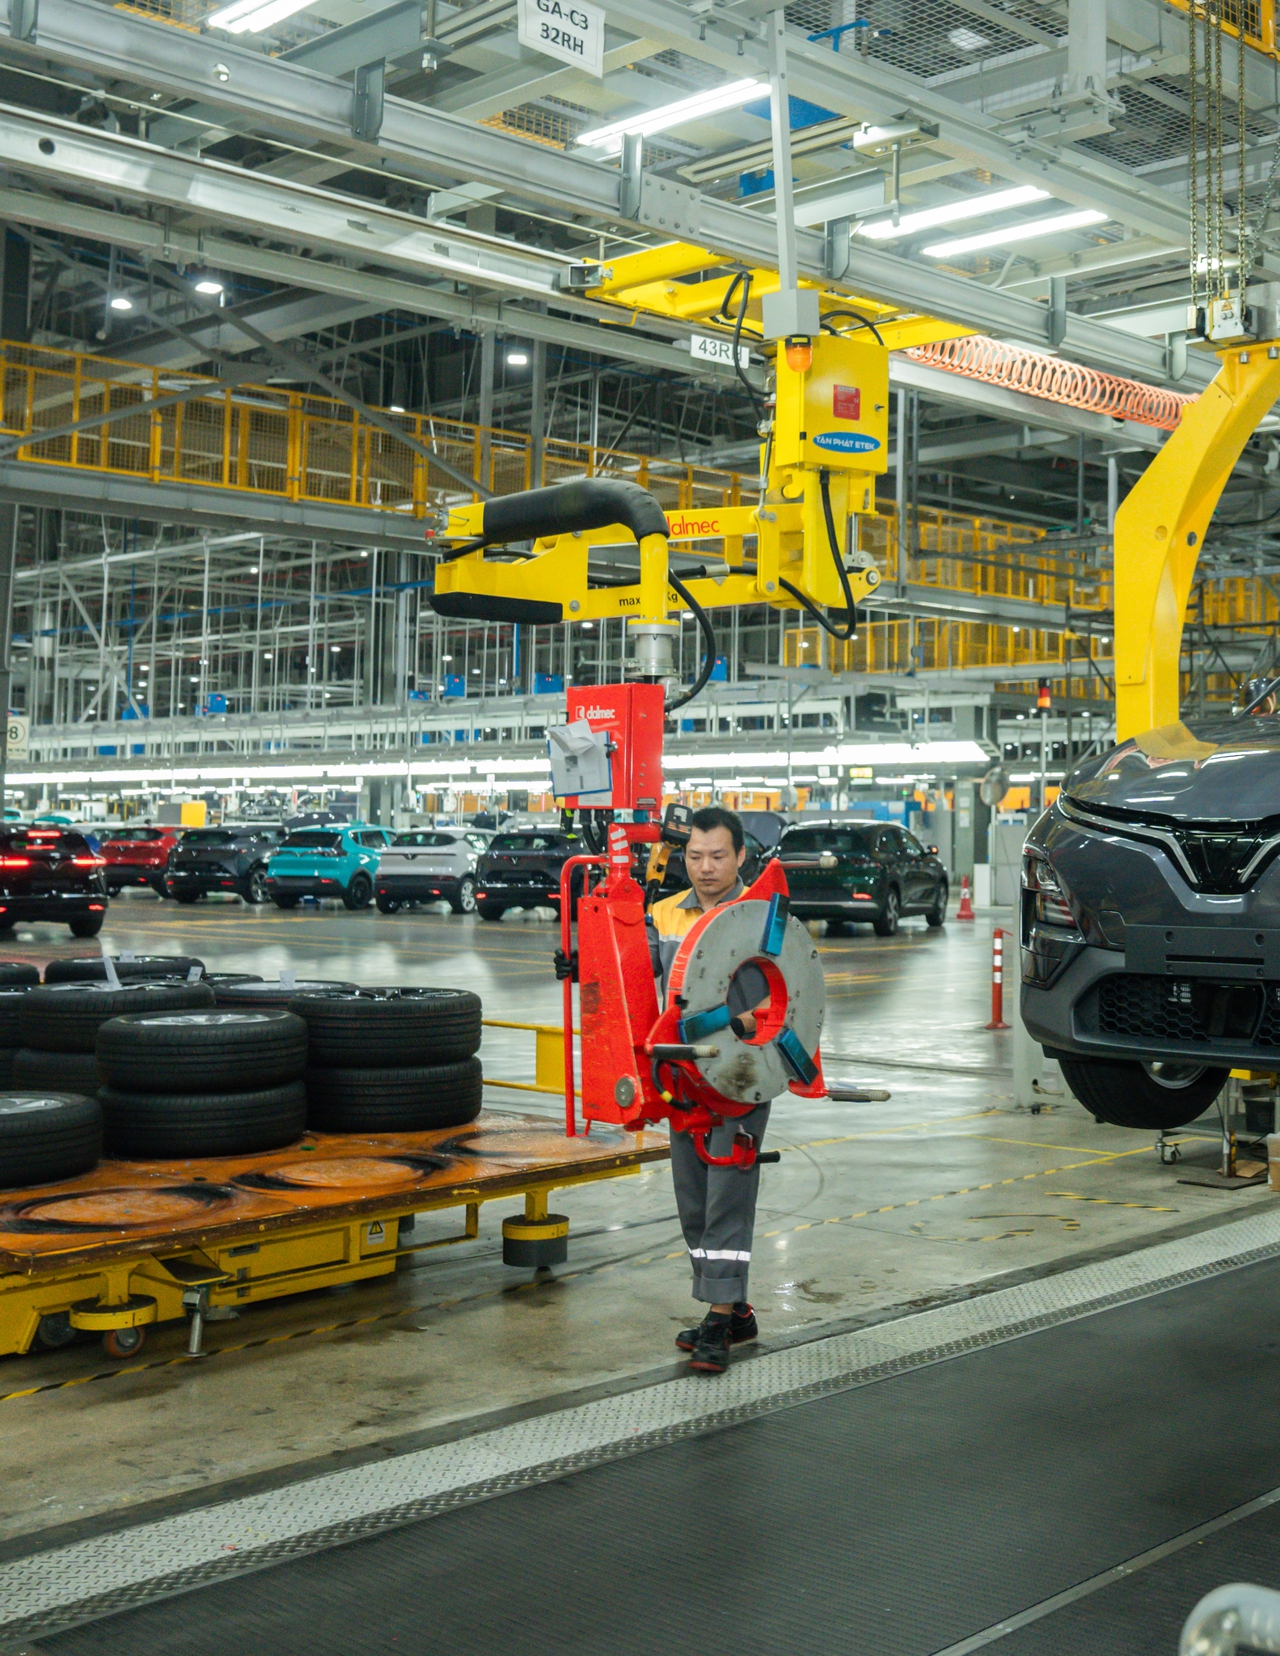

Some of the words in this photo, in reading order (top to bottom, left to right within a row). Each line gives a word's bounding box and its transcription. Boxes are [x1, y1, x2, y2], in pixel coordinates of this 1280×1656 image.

[537, 0, 589, 31] GA-C3
[540, 22, 584, 56] 32RH
[855, 441, 875, 450] ETEK
[619, 597, 641, 607] max
[586, 705, 615, 719] dalmec
